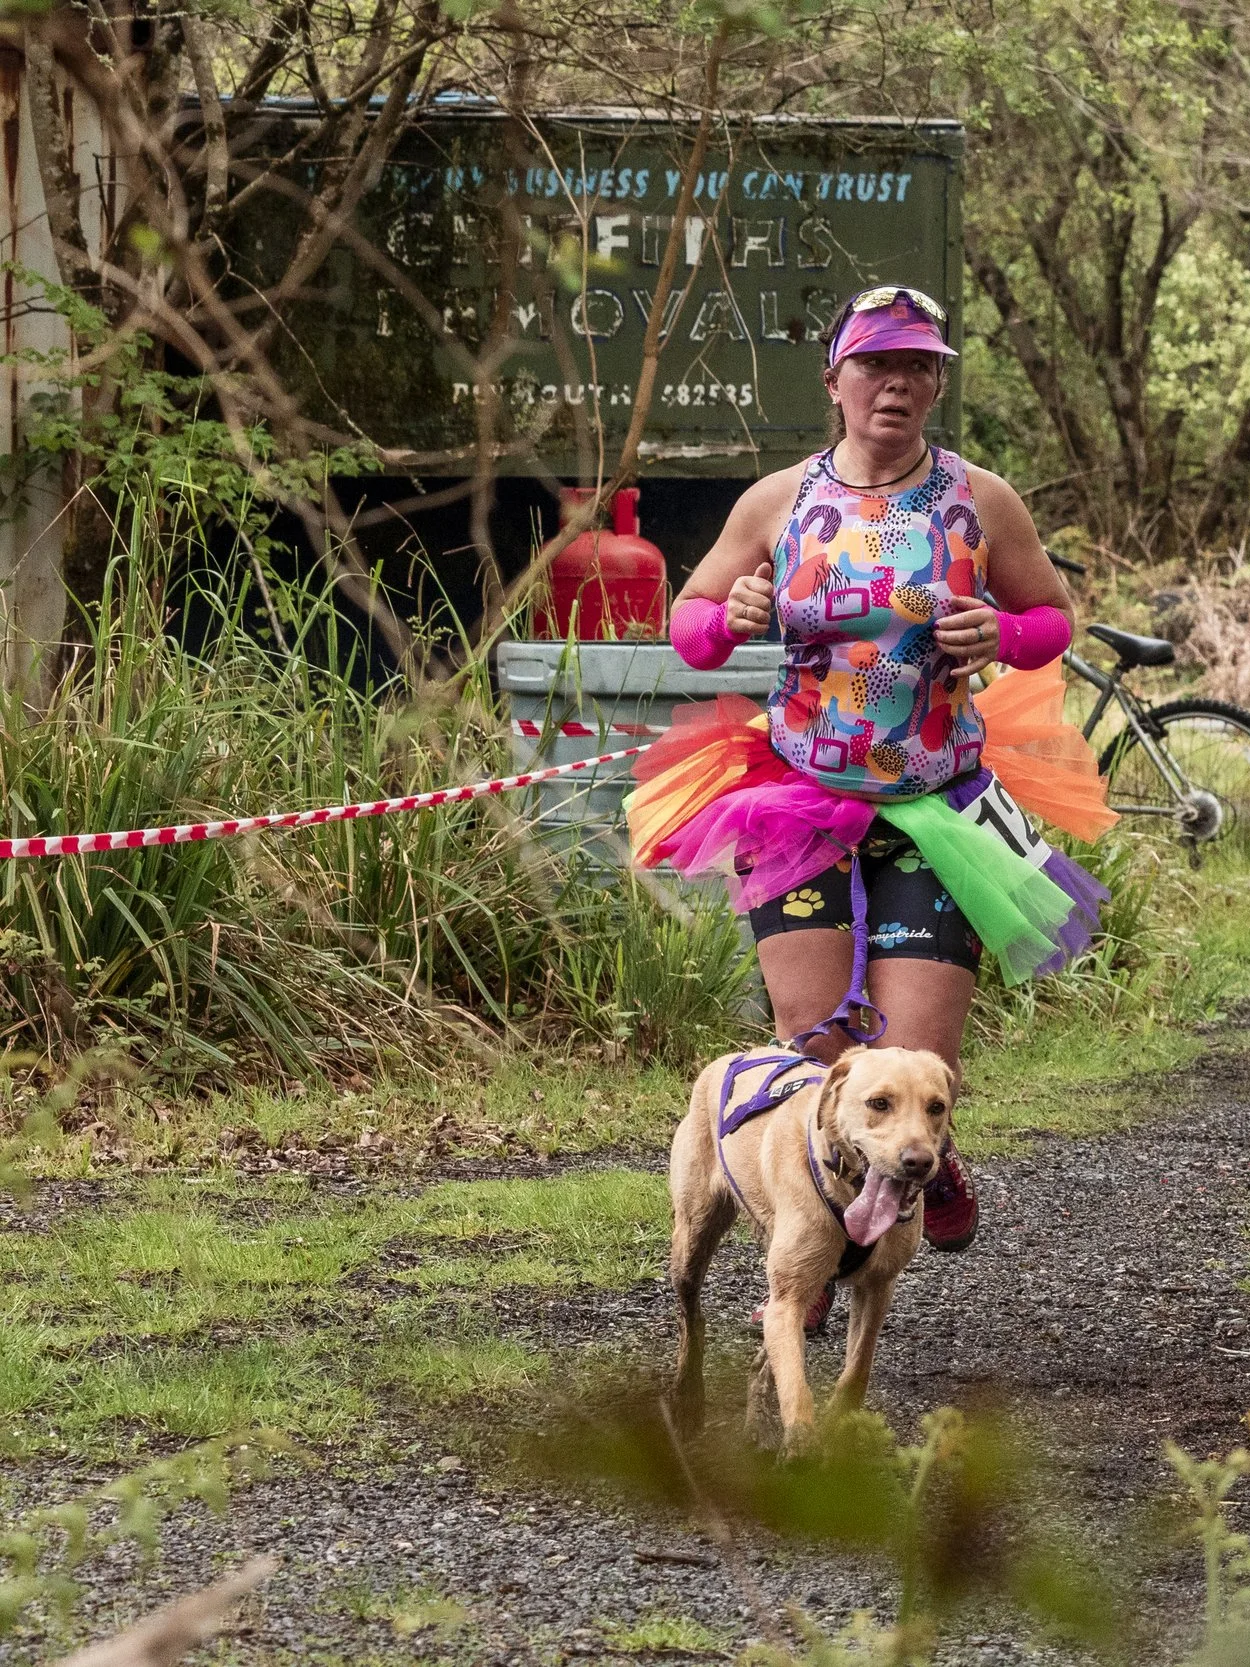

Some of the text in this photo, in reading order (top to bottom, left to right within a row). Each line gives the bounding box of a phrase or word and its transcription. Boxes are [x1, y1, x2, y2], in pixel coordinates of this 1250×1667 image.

[506, 167, 650, 198] BUSINESS
[743, 170, 804, 200] CAN
[819, 171, 912, 202] TRUST
[377, 287, 838, 344] MOVALS
[974, 779, 1041, 858] 12
[867, 927, 934, 945] ppystride
